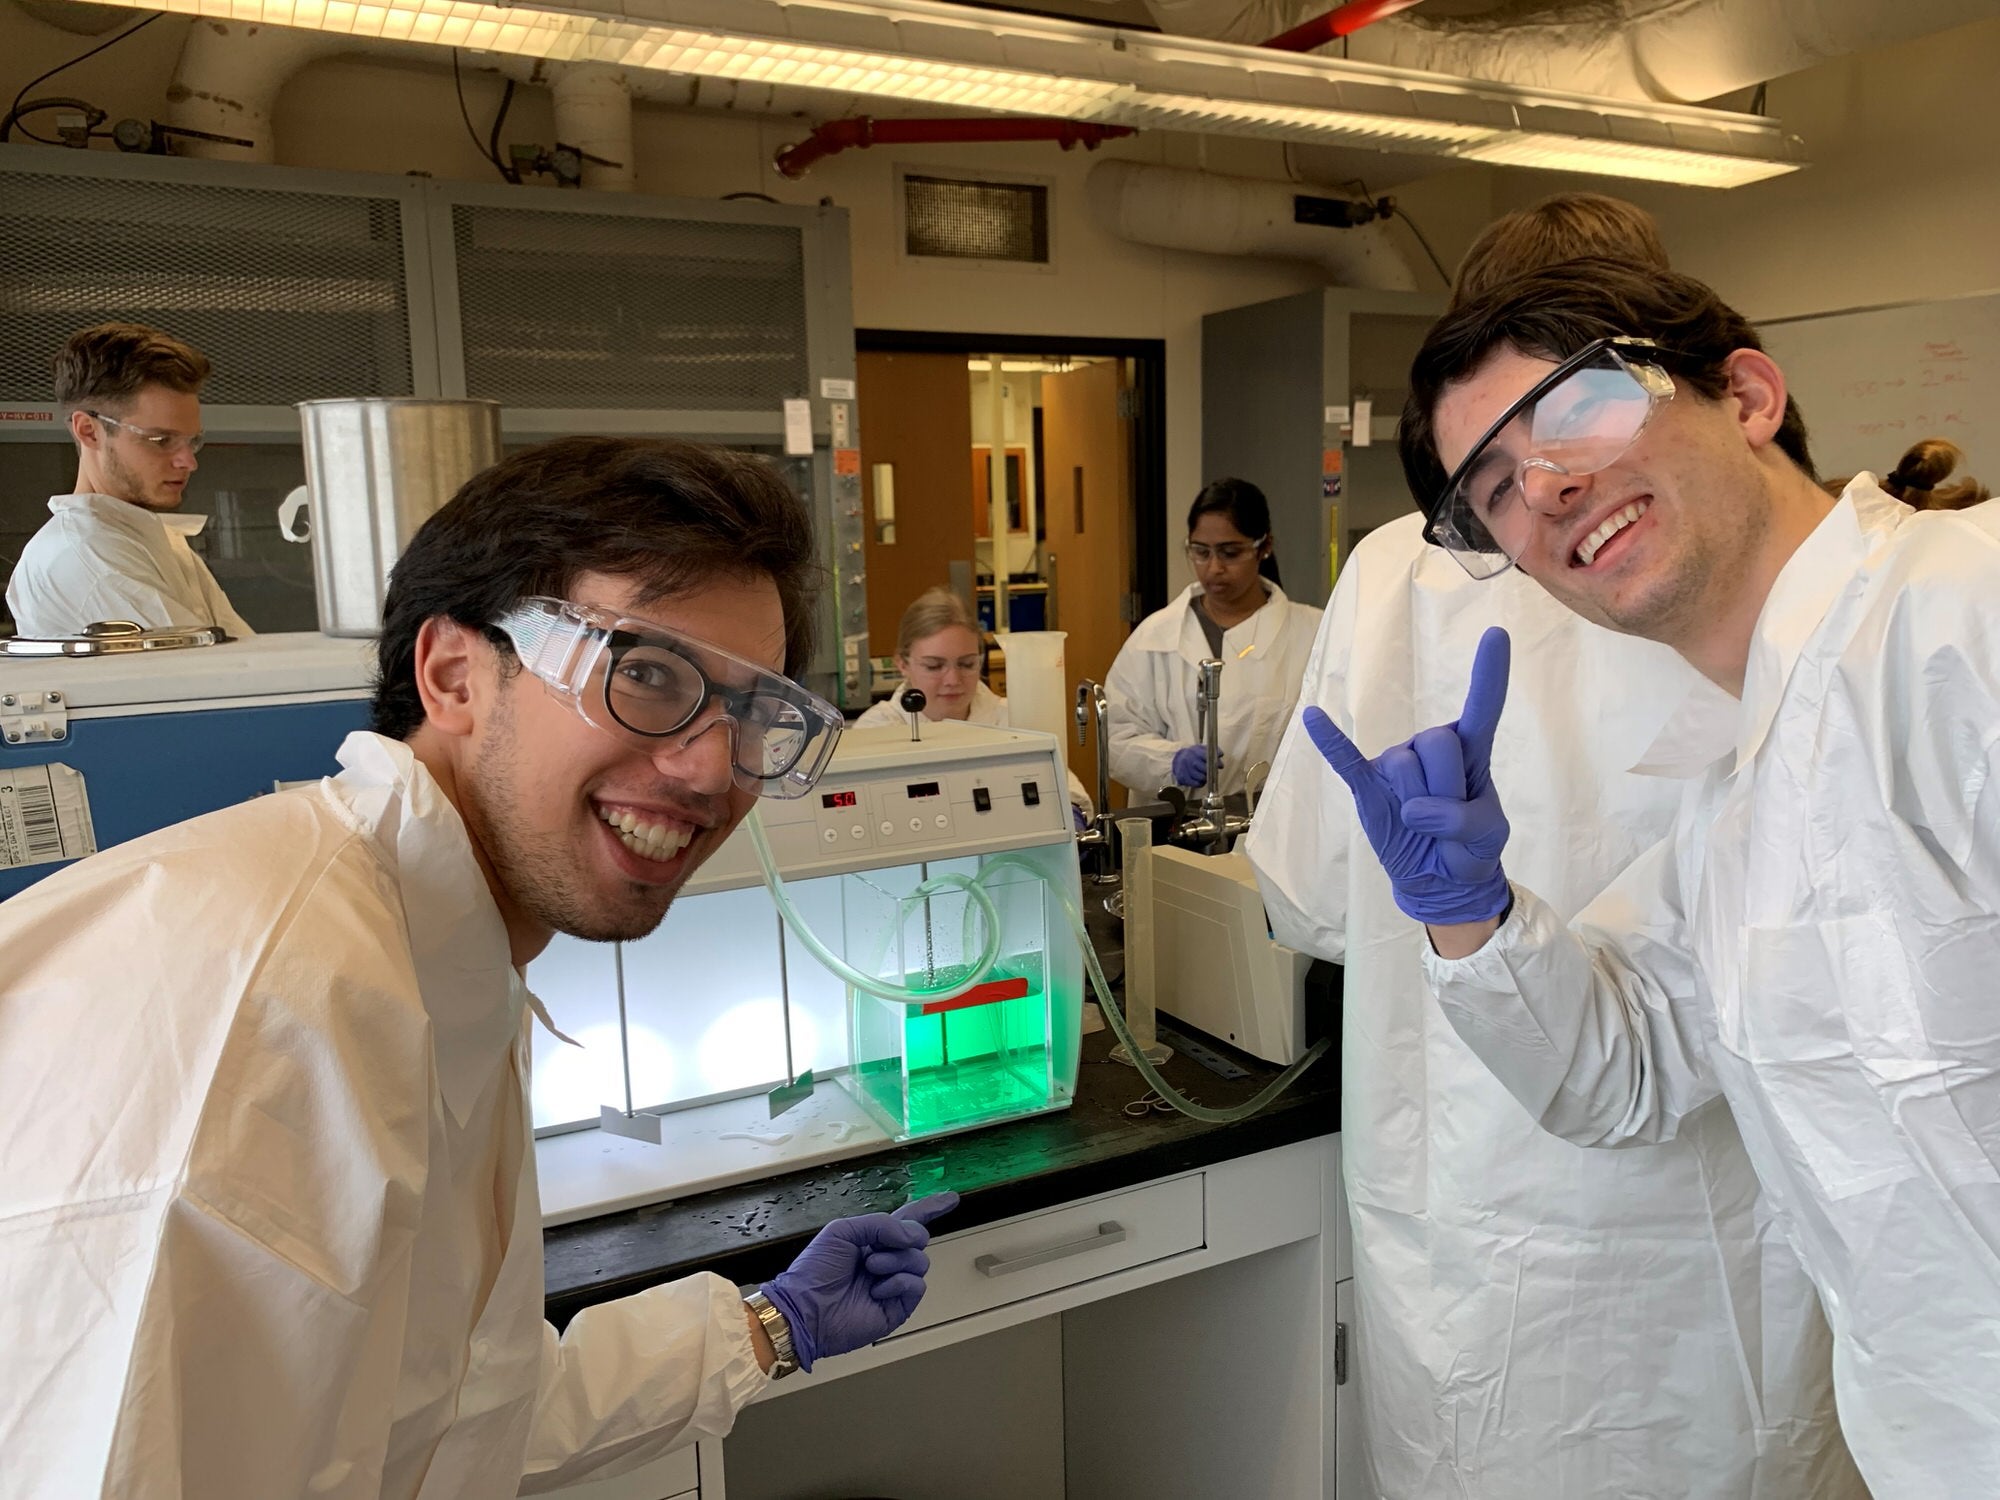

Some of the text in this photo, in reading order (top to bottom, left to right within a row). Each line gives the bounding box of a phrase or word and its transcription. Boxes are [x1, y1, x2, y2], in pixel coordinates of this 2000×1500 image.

[1, 785, 13, 793] 3
[833, 791, 855, 808] 50
[3, 805, 14, 830] SELECT
[9, 831, 17, 845] DAY
